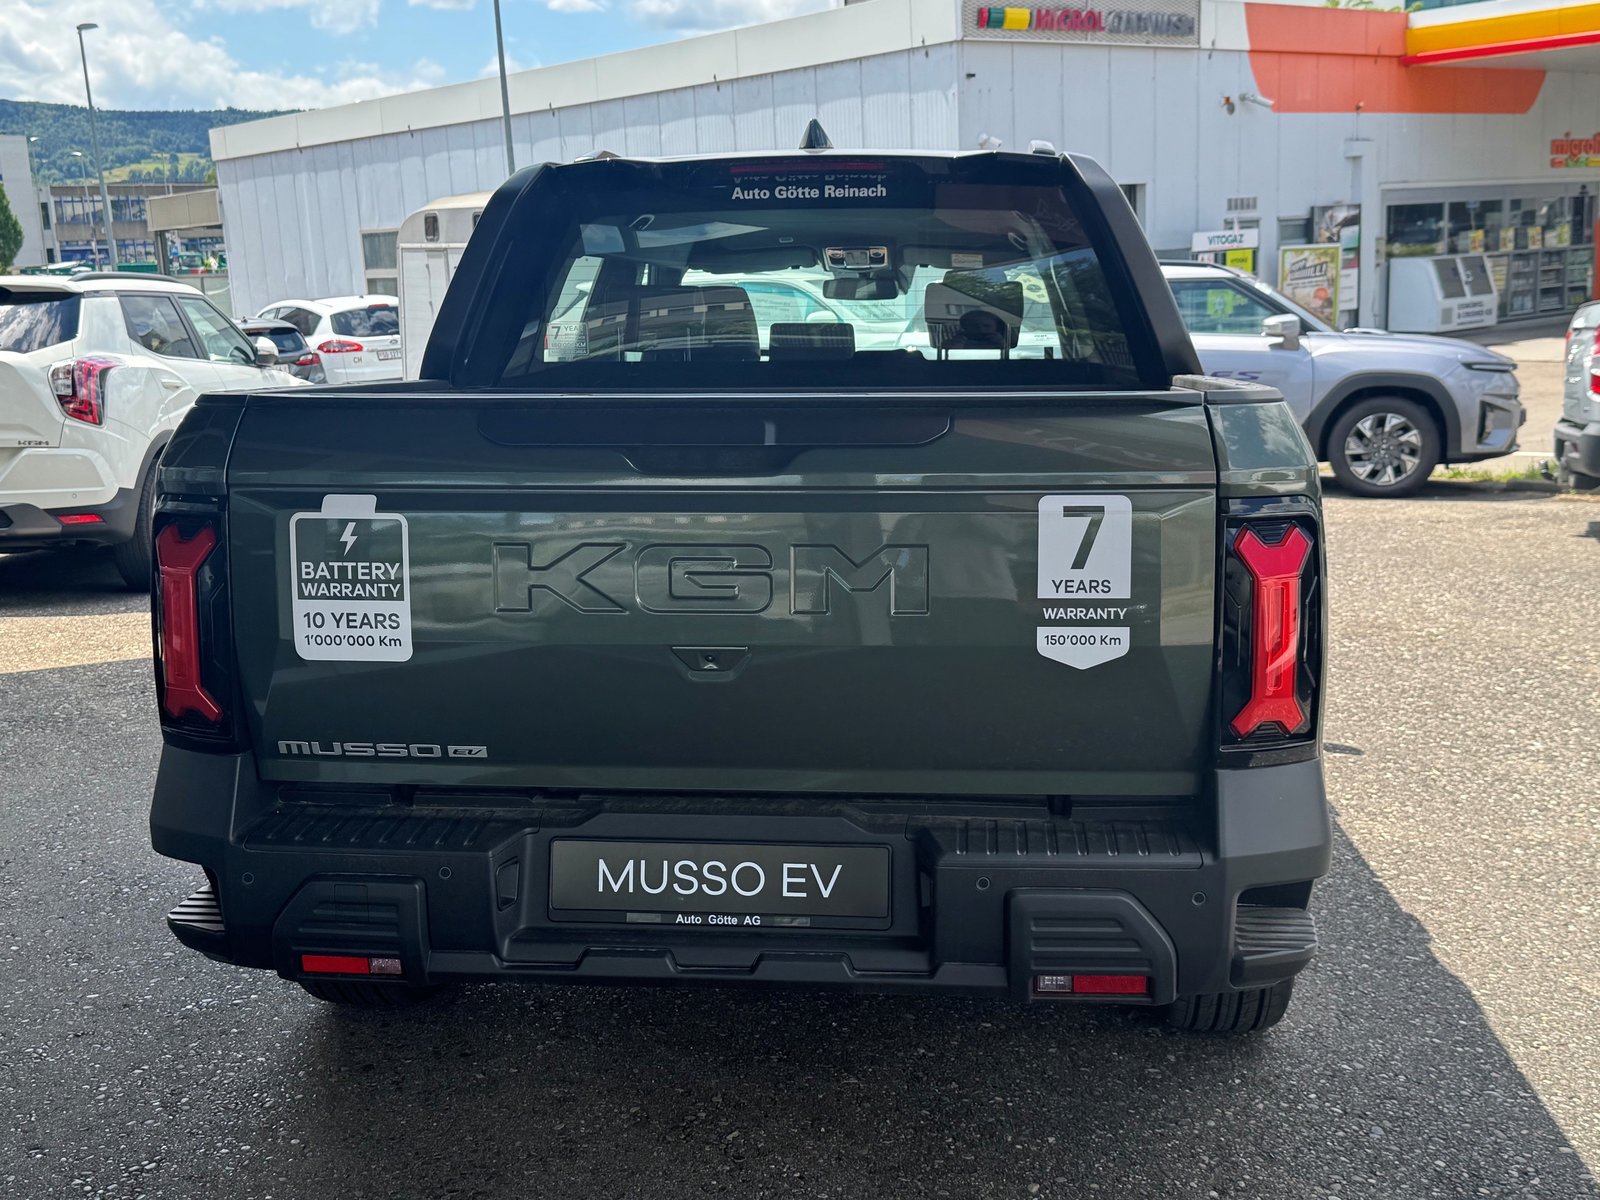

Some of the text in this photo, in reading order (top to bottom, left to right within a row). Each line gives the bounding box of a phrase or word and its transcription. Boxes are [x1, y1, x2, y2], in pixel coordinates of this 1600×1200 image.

[1034, 8, 1105, 33] MIGROL
[731, 183, 887, 200] Auto Götte Reinach
[1207, 233, 1244, 246] VITOGAZ
[353, 356, 363, 364] CH
[1062, 505, 1105, 570] 7
[301, 561, 400, 580] BATTERY
[491, 541, 931, 616] KGM
[301, 582, 401, 597] WARRANTY
[1051, 579, 1112, 594] YEARS
[303, 612, 400, 630] 10 YEARS
[1042, 607, 1127, 620] WARRANTY
[304, 634, 402, 647] 1'000'000 Km
[1044, 634, 1121, 646] 150'000 Km
[278, 740, 487, 758] MUSSO EV
[598, 858, 843, 898] MUSSO EV
[675, 913, 761, 926] Auto Götte AG
